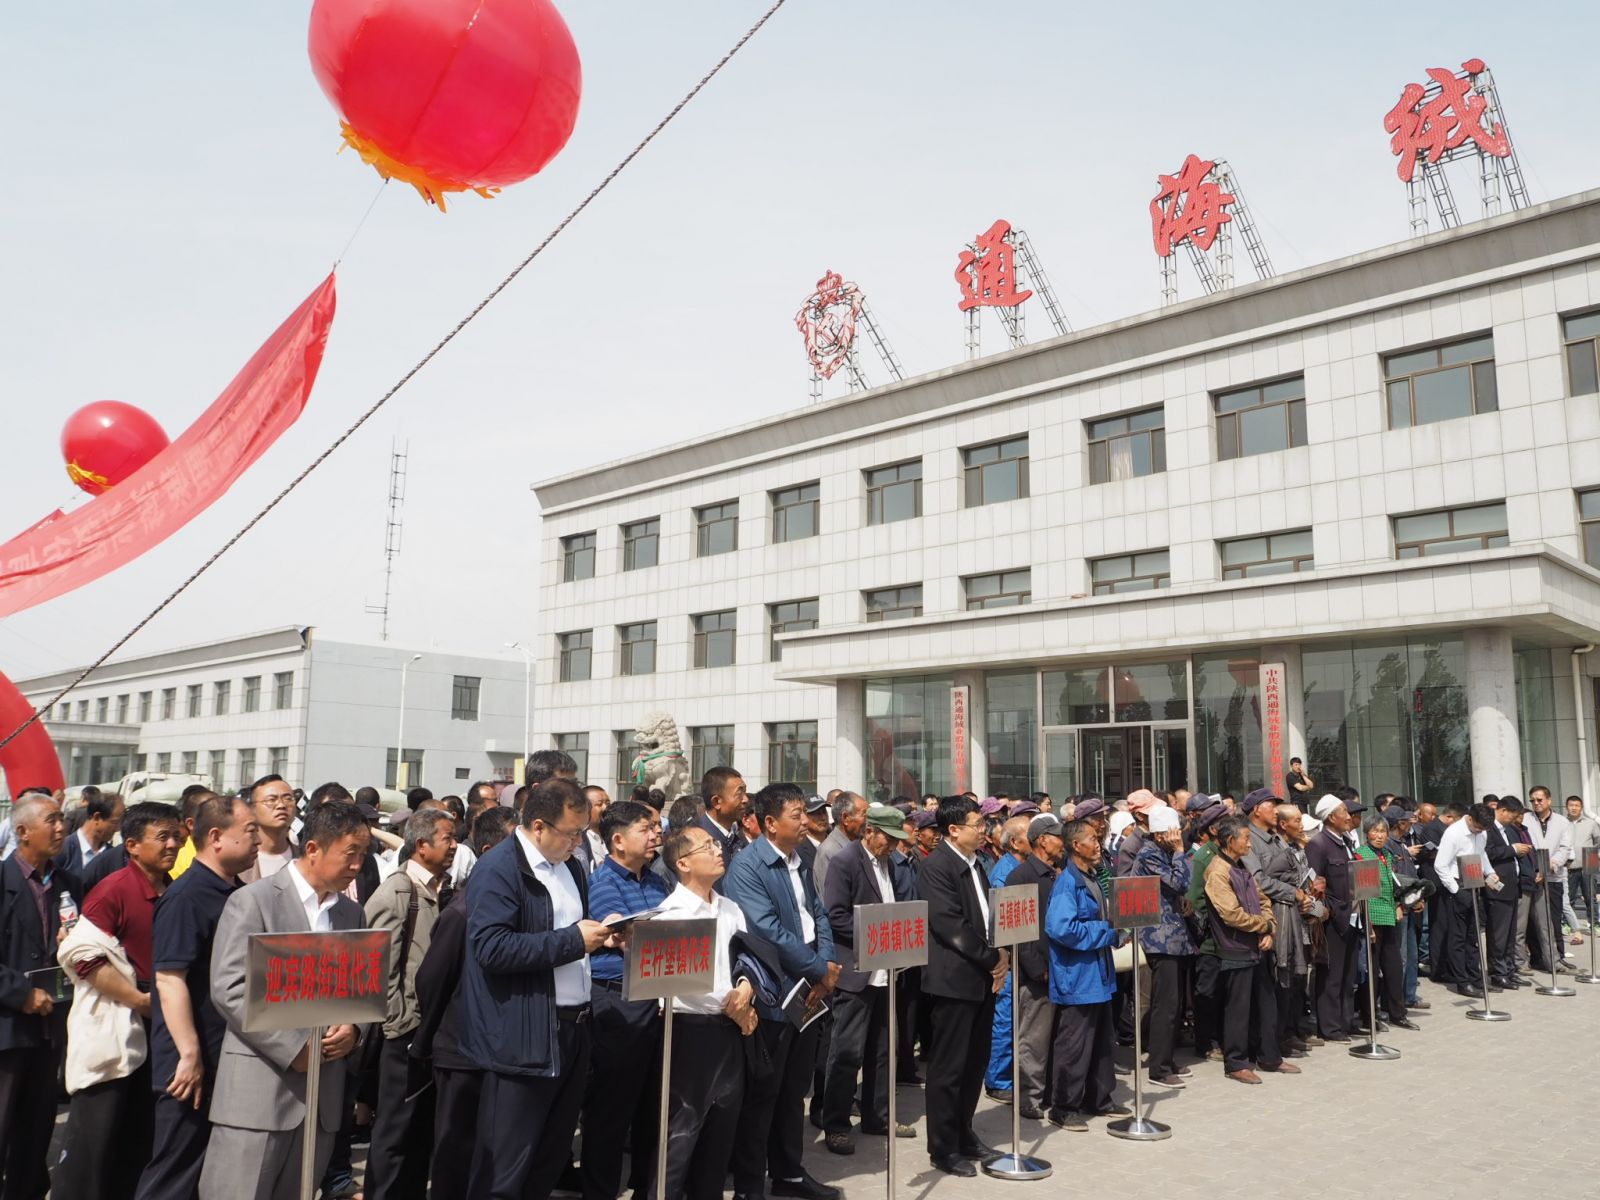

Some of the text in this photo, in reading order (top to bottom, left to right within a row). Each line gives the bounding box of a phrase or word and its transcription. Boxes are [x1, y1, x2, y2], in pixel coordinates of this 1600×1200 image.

[265, 948, 383, 1003] 迎宾路街道代表
